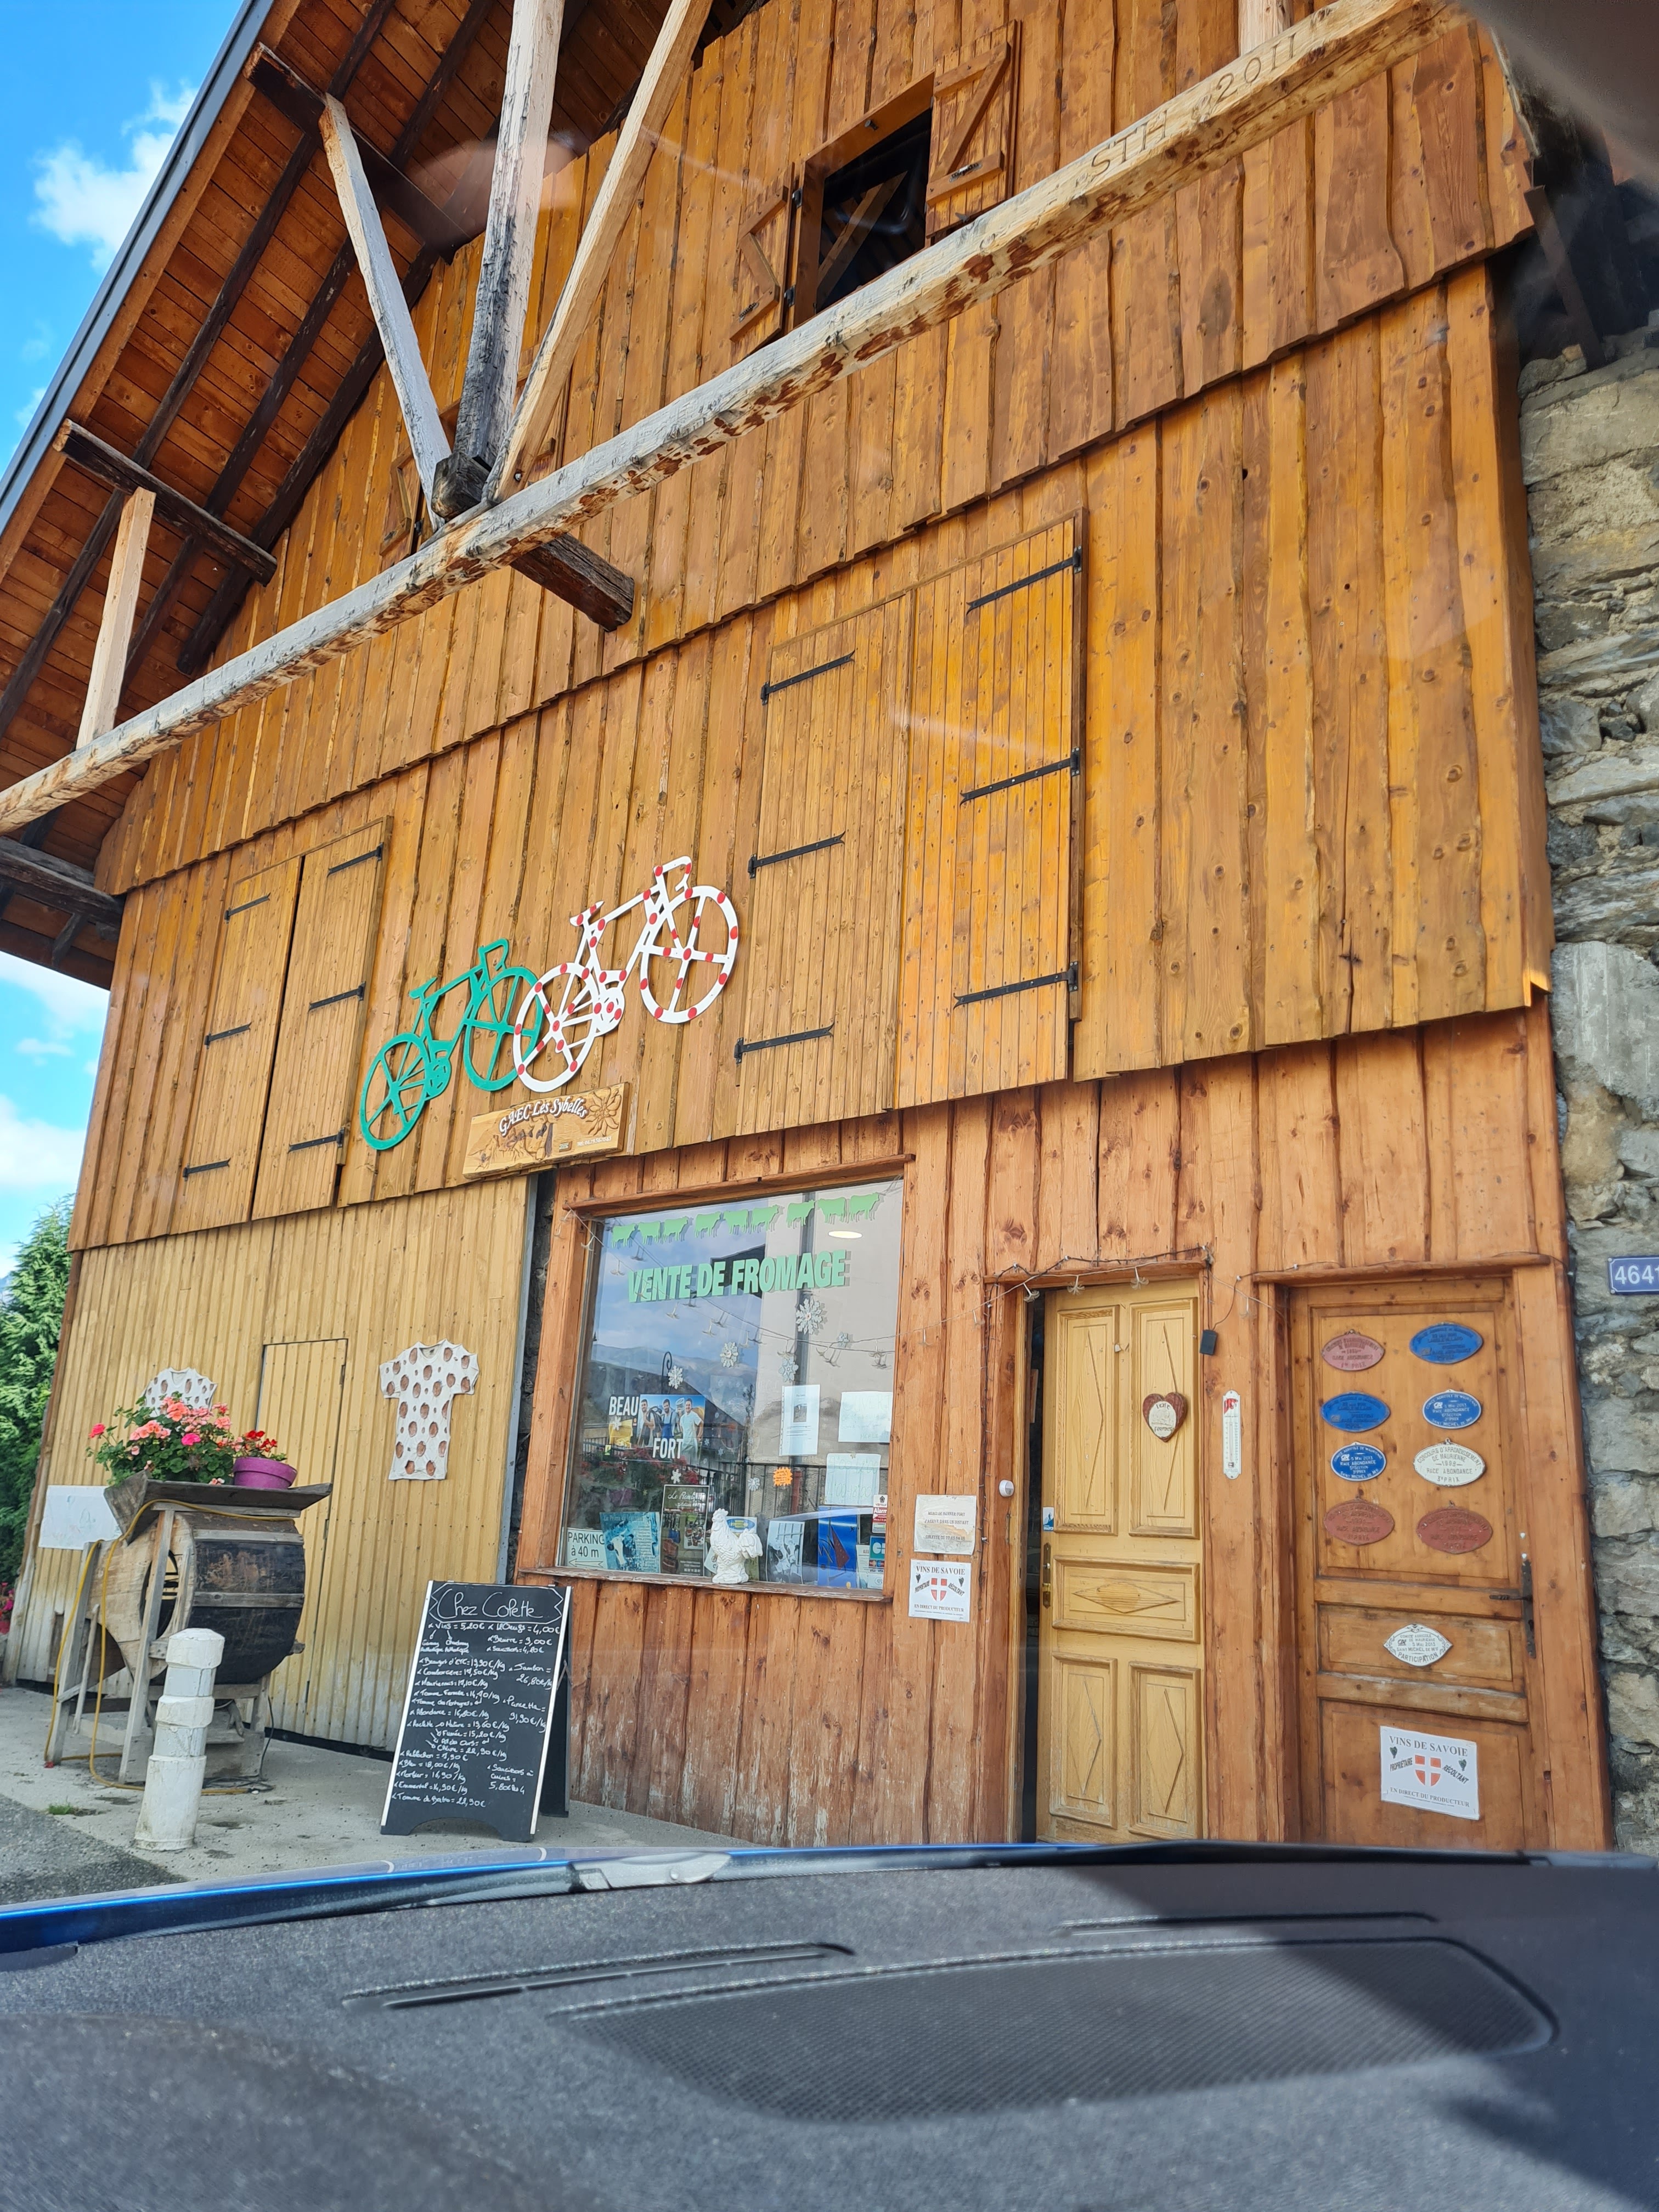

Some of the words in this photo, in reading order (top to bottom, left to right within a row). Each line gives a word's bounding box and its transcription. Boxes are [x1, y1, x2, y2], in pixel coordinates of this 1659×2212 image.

[499, 1103, 532, 1137] GAEC
[532, 1099, 551, 1116] Les
[550, 1096, 588, 1119] Sybelles
[628, 1264, 692, 1303] VENTE
[697, 1261, 726, 1297] DE
[731, 1249, 847, 1295] FROMAGE
[608, 1396, 639, 1416] BEAU
[652, 1438, 684, 1459] FORT
[1417, 1448, 1439, 1464] CONCOURS
[1440, 1453, 1467, 1463] MAURIENNE
[571, 1545, 576, 1556] à
[578, 1546, 588, 1557] 40
[591, 1548, 599, 1558] m
[437, 1589, 478, 1619] Chez
[482, 1592, 543, 1618] Colette
[493, 1635, 517, 1643] Beurre
[514, 1662, 544, 1672] Jambon
[1397, 1652, 1438, 1663] PARTICIPATION
[416, 1707, 446, 1716] Abondance
[1389, 1735, 1411, 1747] VINS
[1414, 1740, 1427, 1750] DE
[1430, 1743, 1468, 1757] SAVOIE
[1442, 1764, 1469, 1784] RÉCOLTANT
[1398, 1788, 1419, 1797] DIRECT
[1430, 1795, 1470, 1808] PRODUCTEUR
